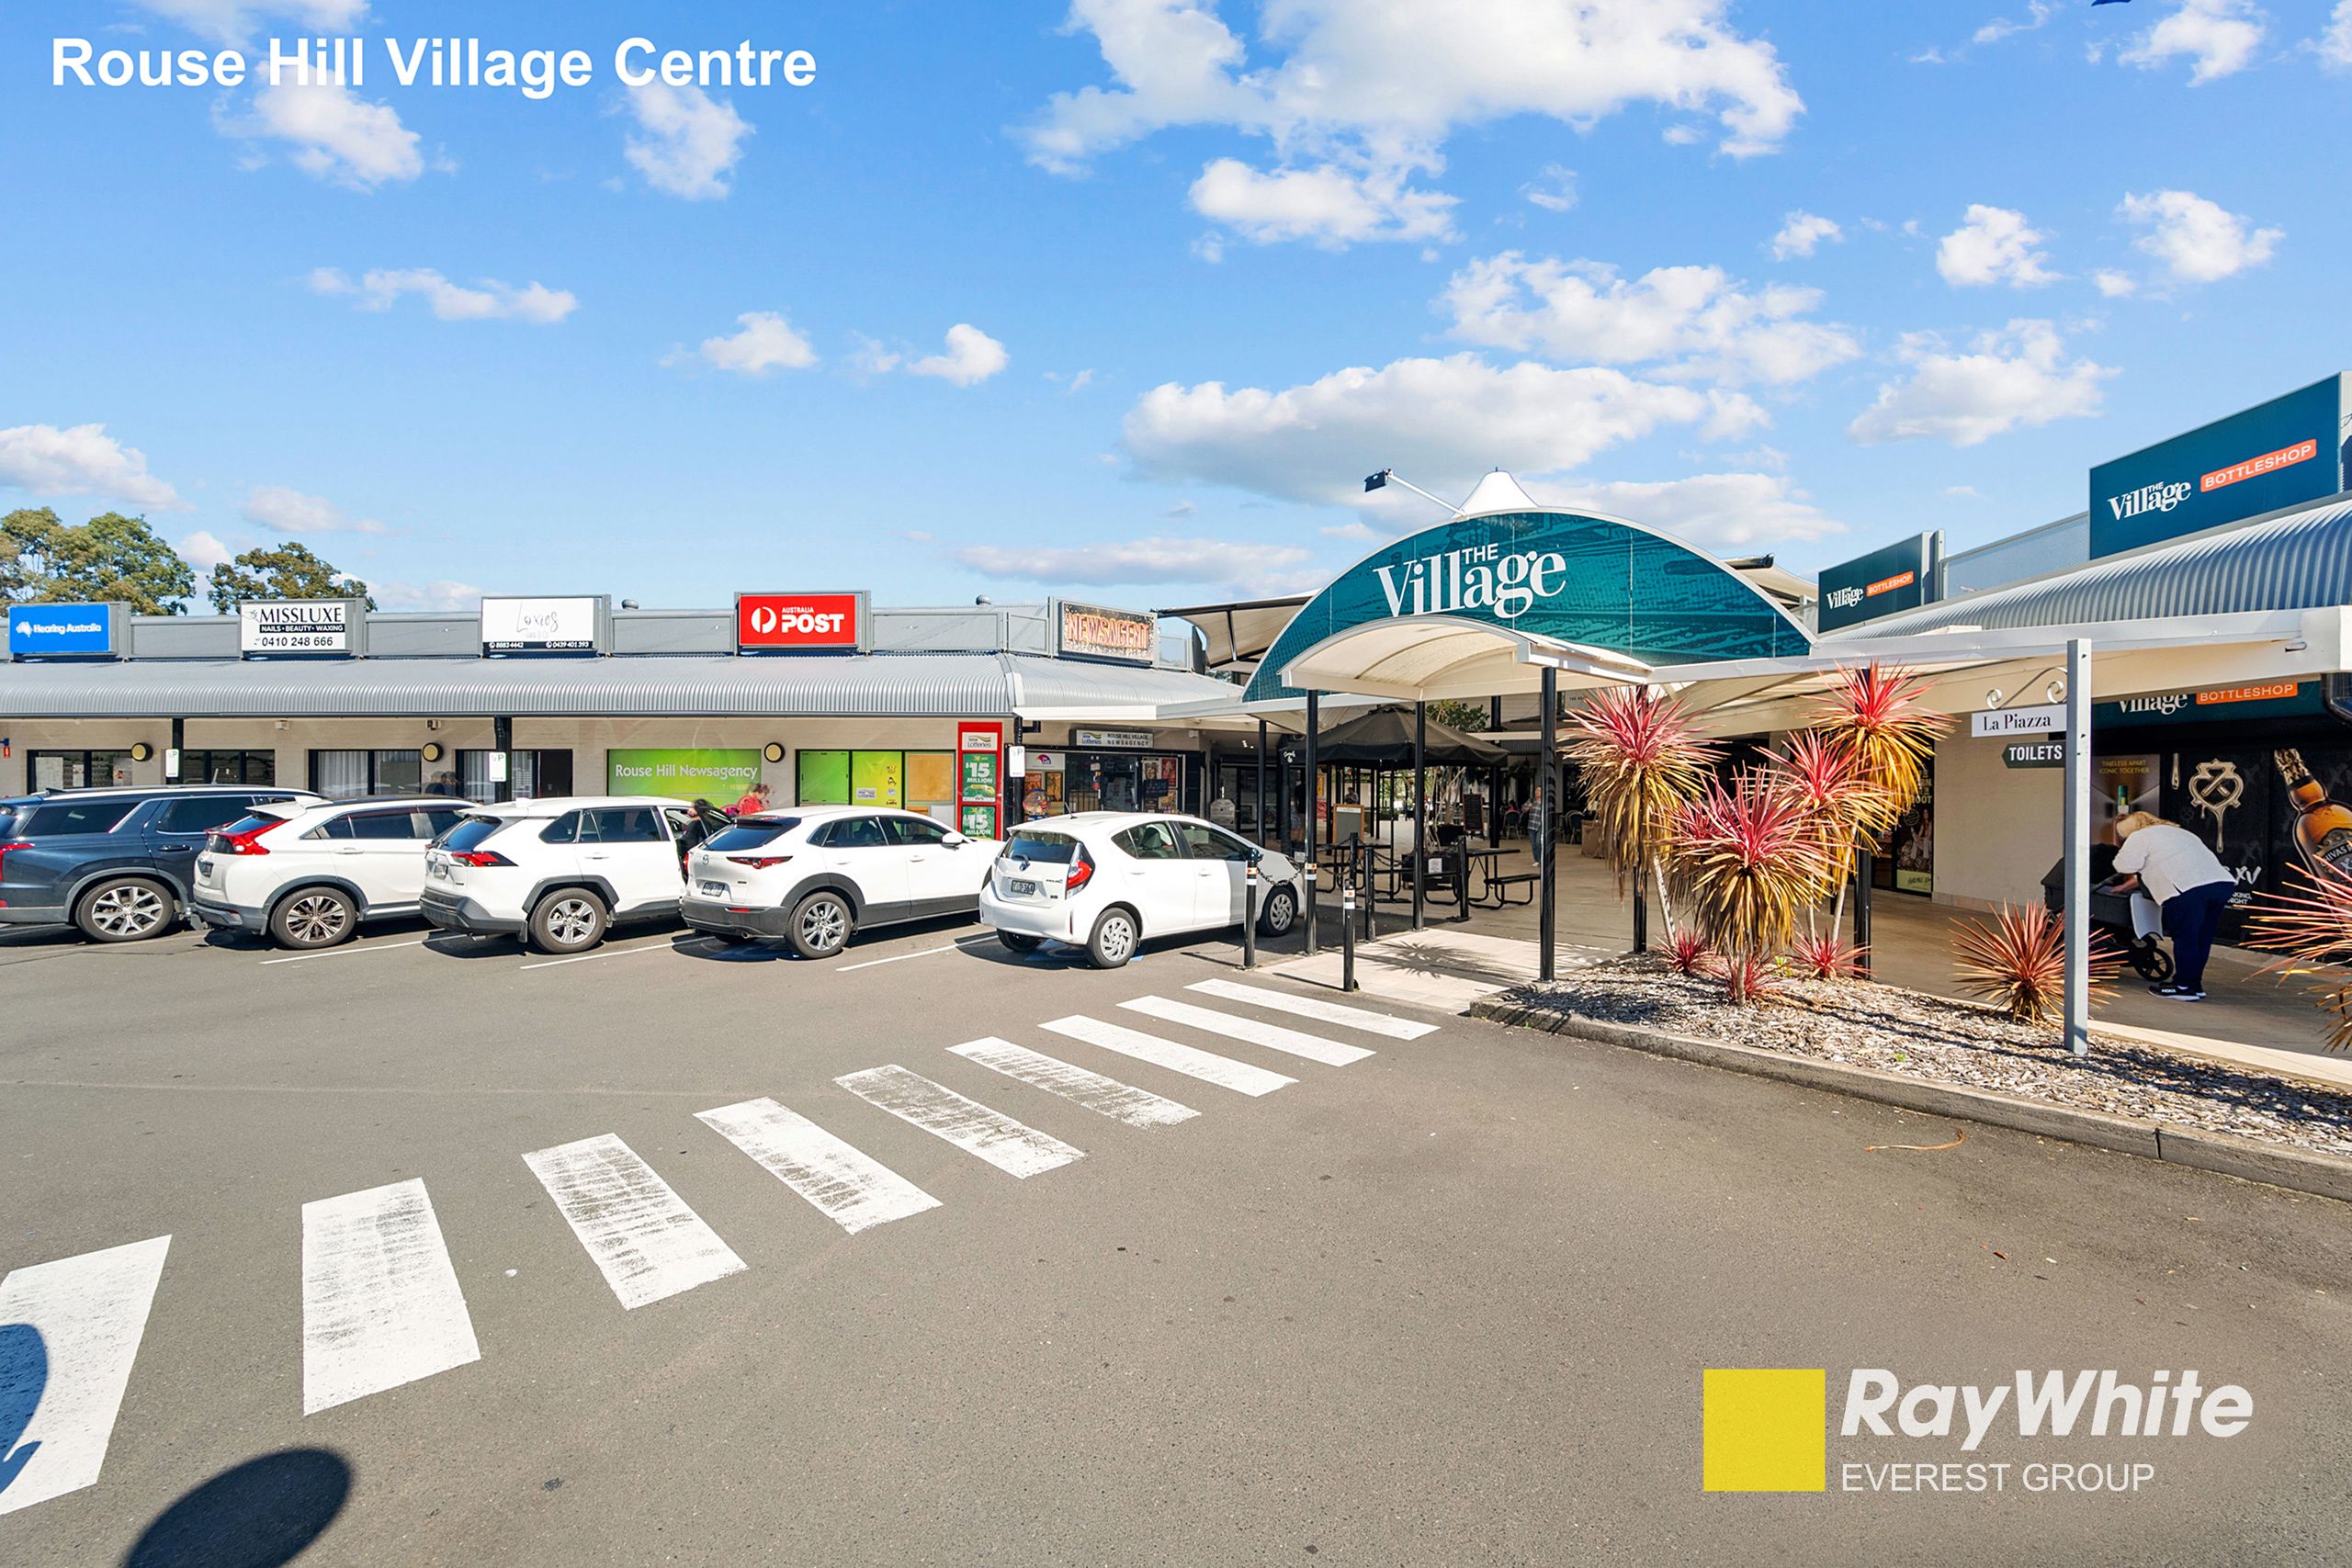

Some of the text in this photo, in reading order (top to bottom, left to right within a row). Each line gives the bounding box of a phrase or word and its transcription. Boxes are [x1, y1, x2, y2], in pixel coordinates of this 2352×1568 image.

[2205, 445, 2312, 489] BOTTLESHOP
[2148, 481, 2165, 494] THE
[2108, 481, 2192, 521] Village
[1462, 543, 1498, 565] THE
[1373, 550, 1566, 619] Village
[1868, 574, 1912, 594] BOTTLESHOP
[1826, 587, 1864, 610] Village
[259, 607, 342, 623] MISSLUXE
[781, 614, 845, 633] POST
[33, 624, 101, 635] Hearing Australia
[1067, 613, 1150, 649] NEWSAGENT
[262, 637, 334, 647] 0410 248 666
[2199, 684, 2294, 702] BOTTLESHOP
[1984, 714, 2052, 731] La Piazza
[2009, 745, 2063, 761] TOILETS
[616, 764, 758, 780] Rouse Hill Newsagency
[966, 762, 990, 778] $15
